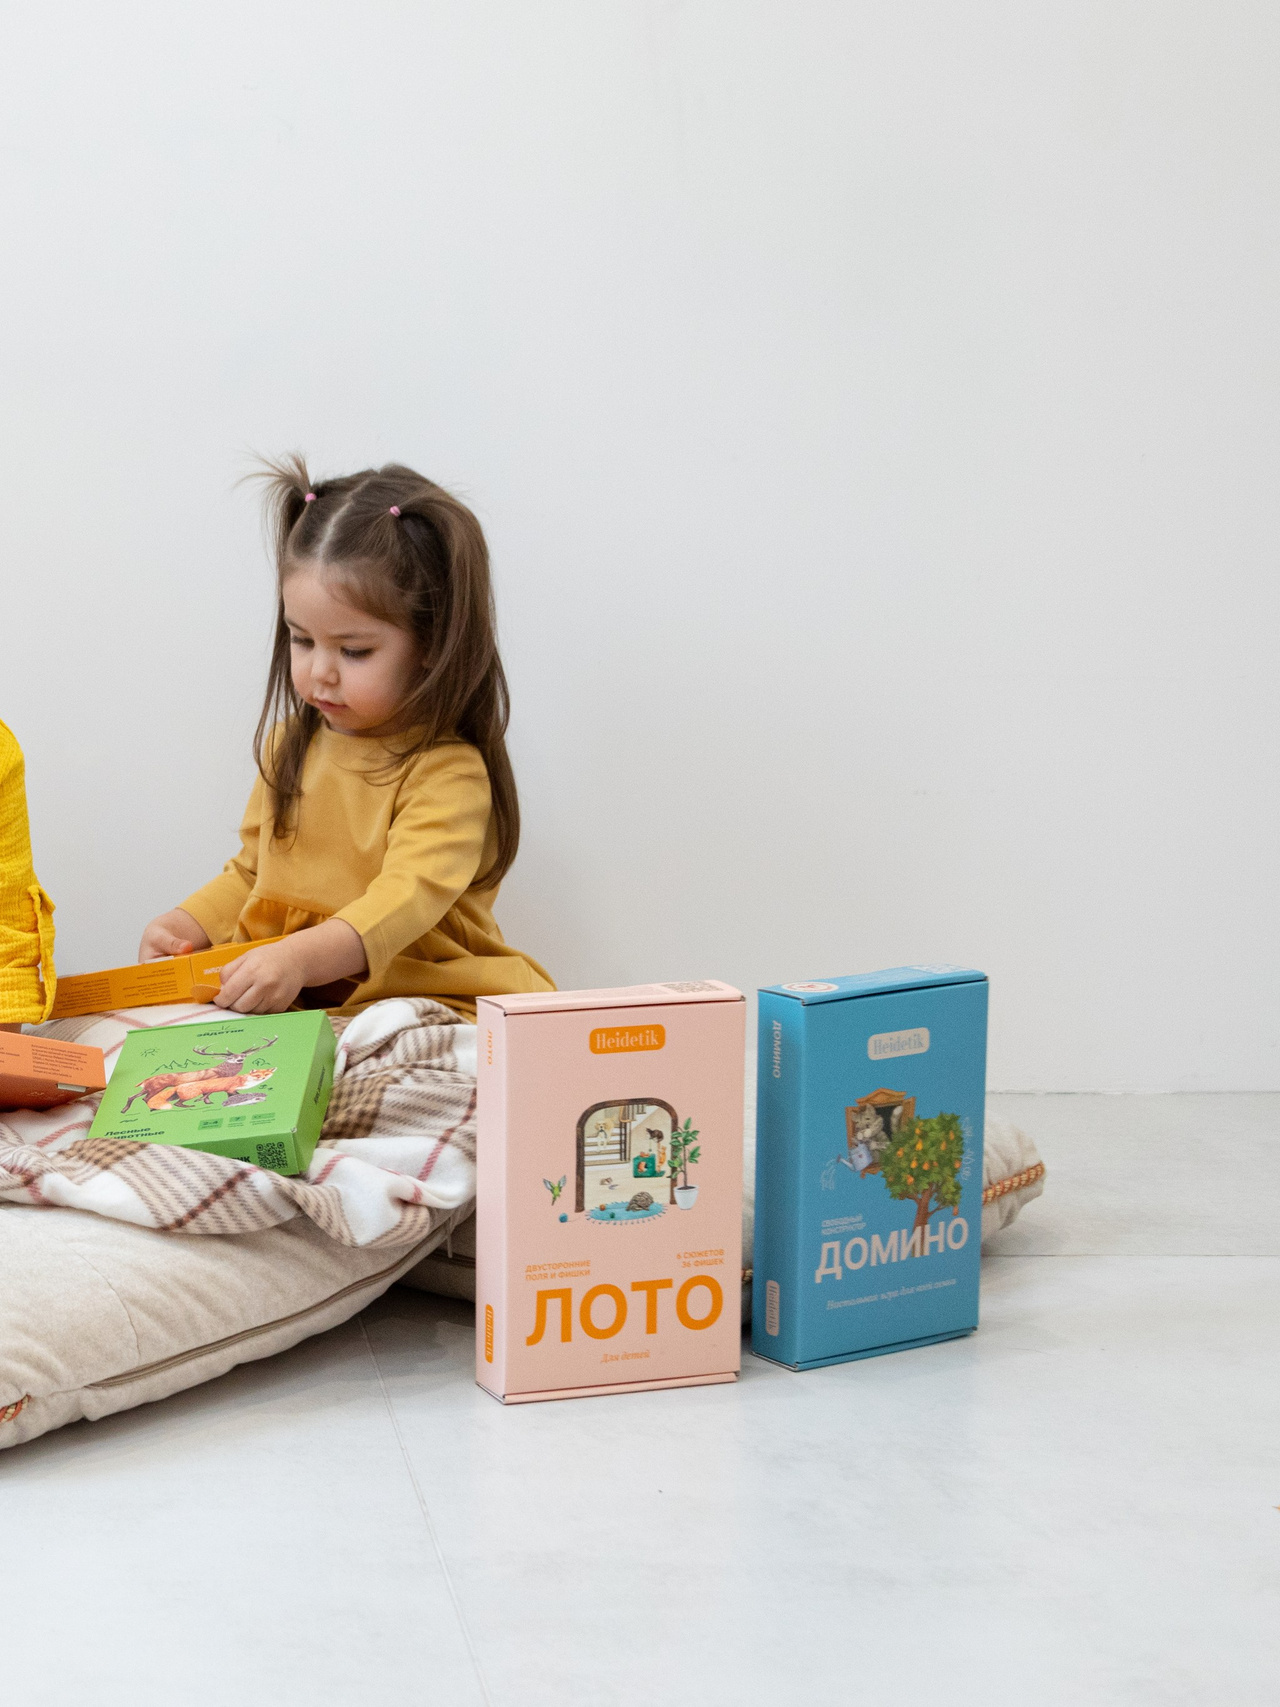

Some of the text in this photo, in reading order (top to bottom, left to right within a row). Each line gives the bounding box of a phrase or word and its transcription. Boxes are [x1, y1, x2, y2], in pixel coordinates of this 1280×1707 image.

[596, 1030, 659, 1049] Heidetik
[872, 1032, 924, 1055] Heidetik
[772, 1019, 782, 1078] ДОМИНО
[104, 1127, 151, 1136] Лесные
[683, 1248, 725, 1260] СЮЖЕТОВ
[815, 1217, 969, 1284] ДОМИНО
[525, 1260, 591, 1273] ДВУСТОРОННИЕ
[693, 1257, 725, 1267] ФИШЕК
[525, 1272, 549, 1281] ПОЛЯ
[558, 1269, 591, 1279] ФИШКИ
[525, 1275, 724, 1347] ЛОТО
